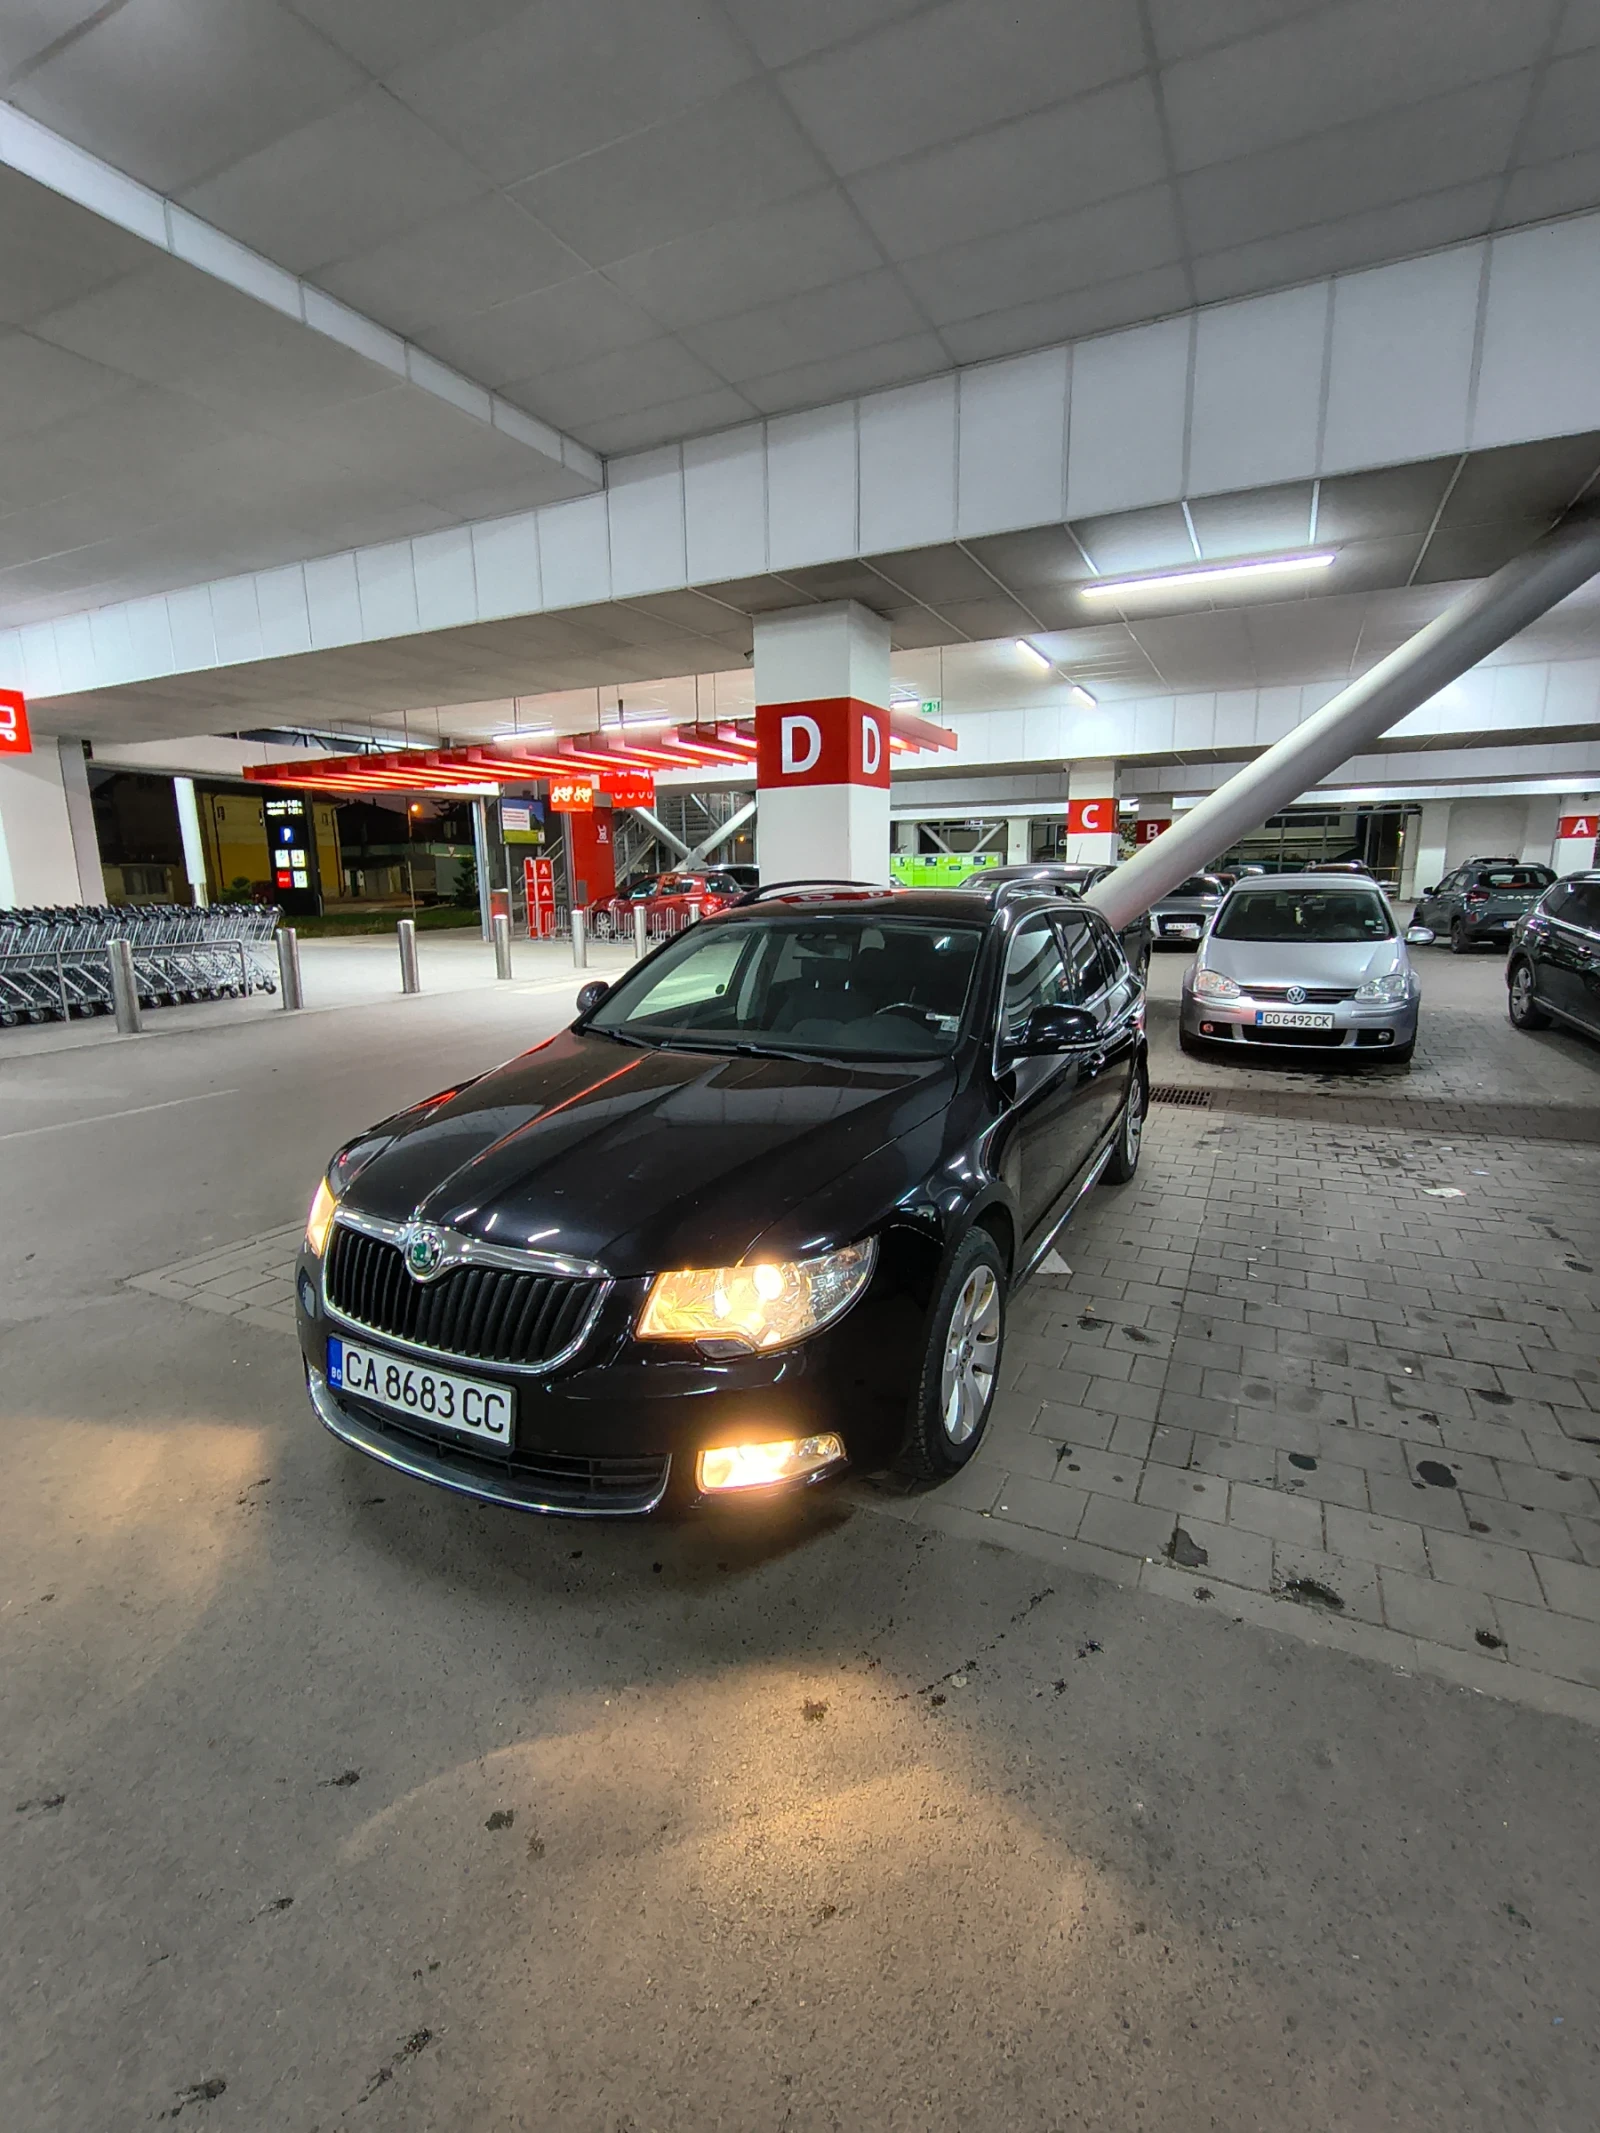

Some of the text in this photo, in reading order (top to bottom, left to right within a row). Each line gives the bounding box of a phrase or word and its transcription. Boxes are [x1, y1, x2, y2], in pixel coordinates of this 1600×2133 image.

[781, 715, 821, 774] D
[862, 715, 880, 774] D
[1081, 804, 1099, 829] C
[284, 828, 291, 841] P
[1146, 823, 1159, 841] B
[1572, 819, 1589, 834] A
[1282, 1014, 1312, 1027] 6492
[1313, 1016, 1331, 1027] CK
[331, 1366, 342, 1381] BG
[346, 1351, 505, 1434] CA 8683 CC
